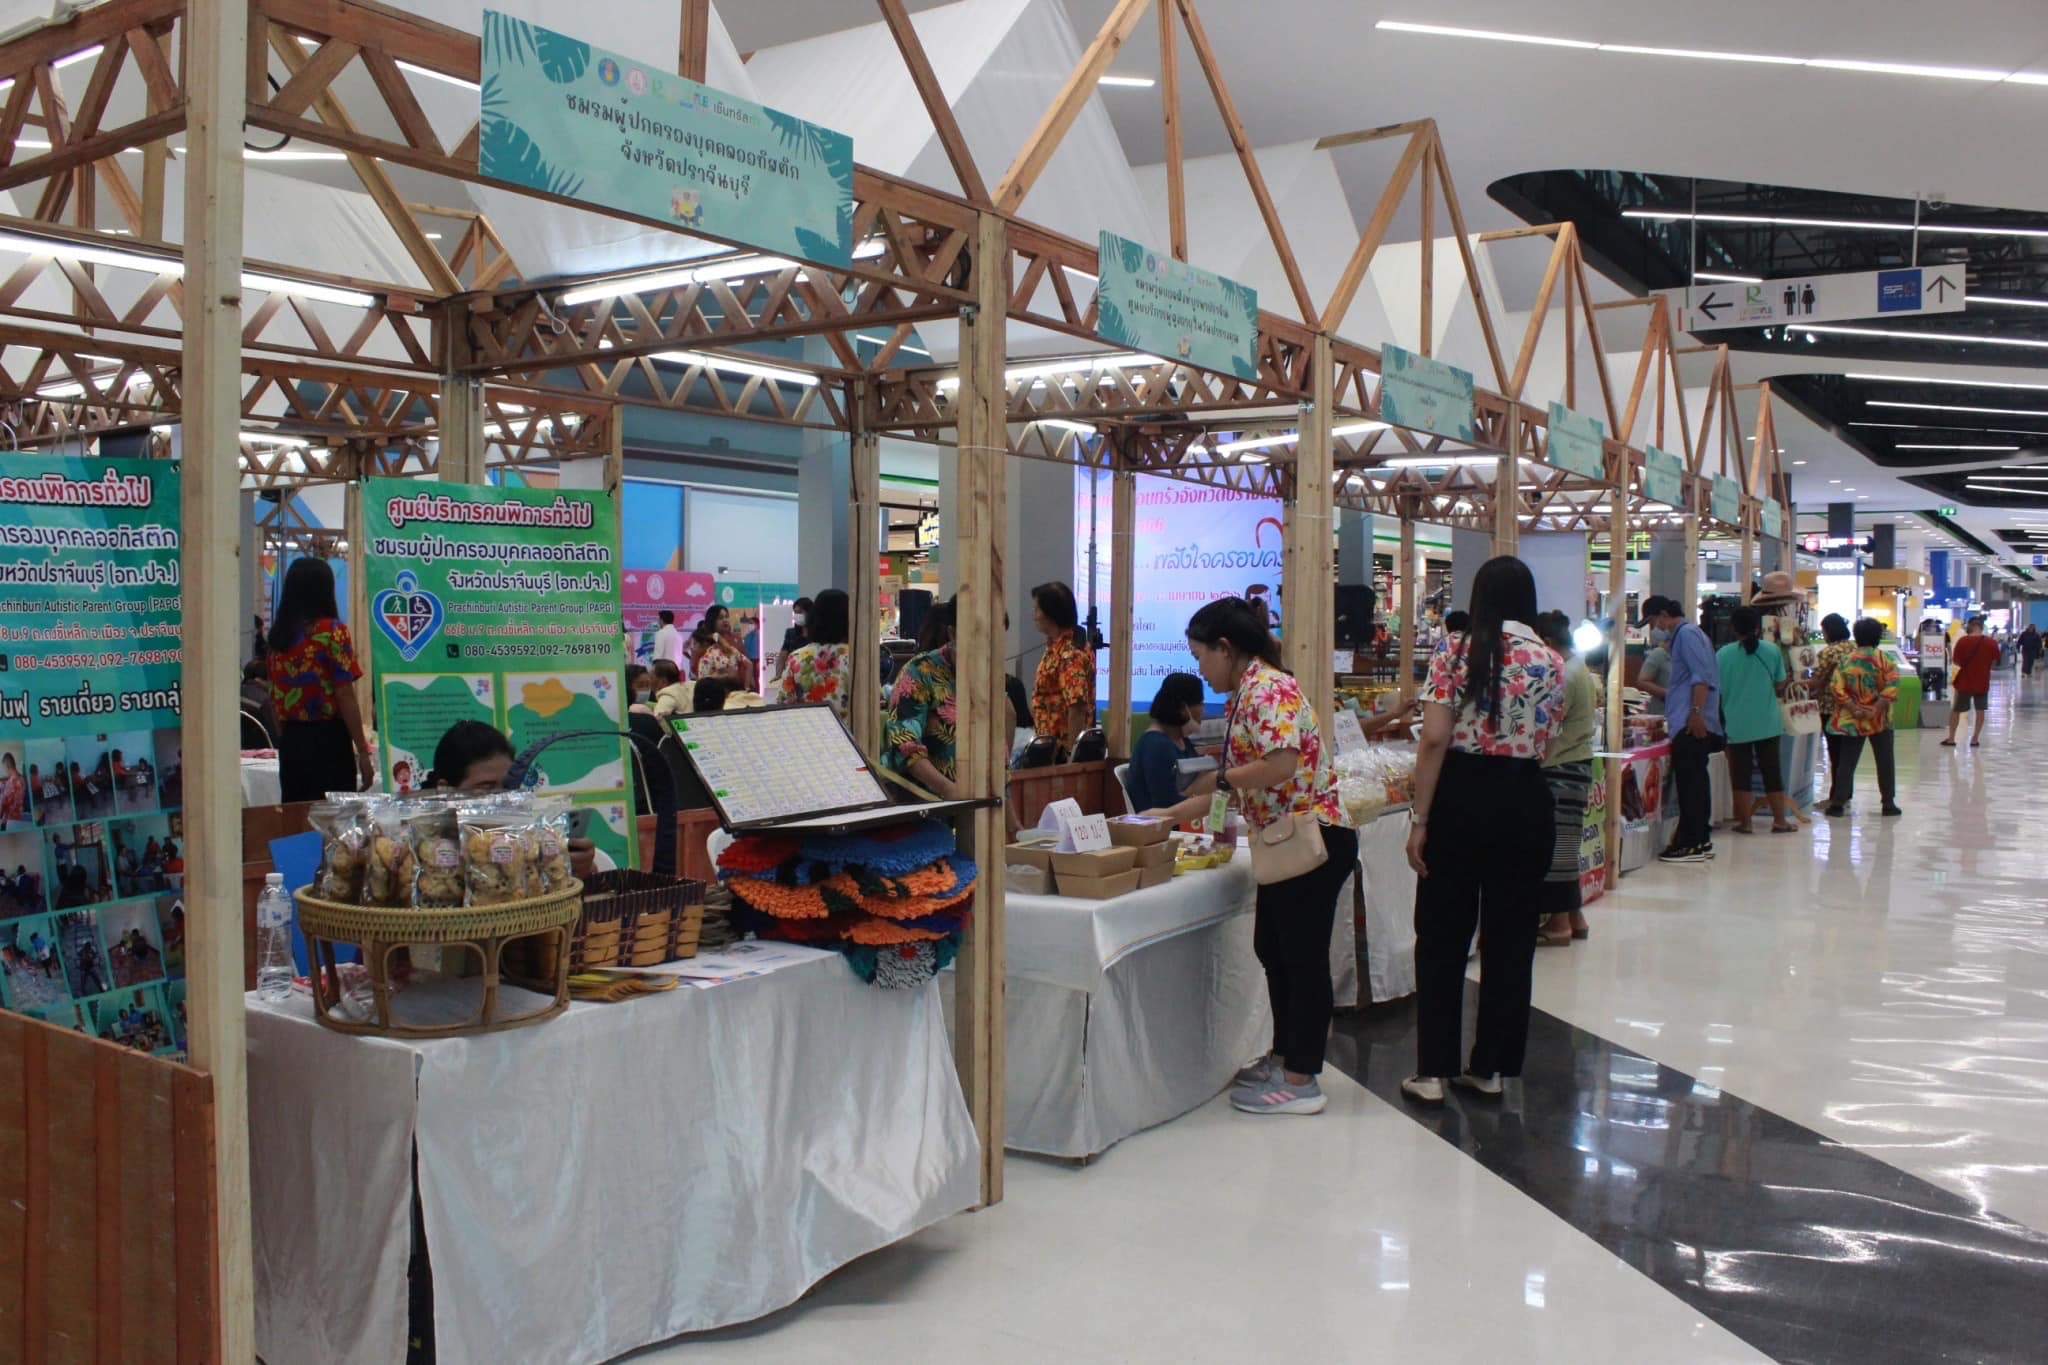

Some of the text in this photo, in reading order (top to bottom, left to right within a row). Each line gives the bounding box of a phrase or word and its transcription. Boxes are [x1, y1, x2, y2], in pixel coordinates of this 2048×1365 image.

[565, 92, 801, 181] ชมรมผู้ปกครองบุคคลออทิสติก
[620, 139, 752, 200] จังหวัดปราจีนบุรี
[388, 495, 591, 526] ศูนย์บริการคนพิการทั่วไป
[375, 535, 609, 565] ชมรมผู้ปกครองบุคคลออทิสติก
[448, 571, 551, 595] จังหวัดปราจีนบุรี
[45, 600, 79, 612] Autistic
[83, 600, 112, 612] Parent
[115, 600, 146, 614] Group
[448, 602, 496, 612] Prachinburi
[498, 603, 529, 612] Autistic
[531, 603, 557, 612] Parent
[560, 603, 584, 614] Group
[464, 643, 611, 656] 080-4539592,092-7698190
[40, 682, 115, 716] รายเดี่ยว
[121, 682, 182, 714] รายกลุ่
